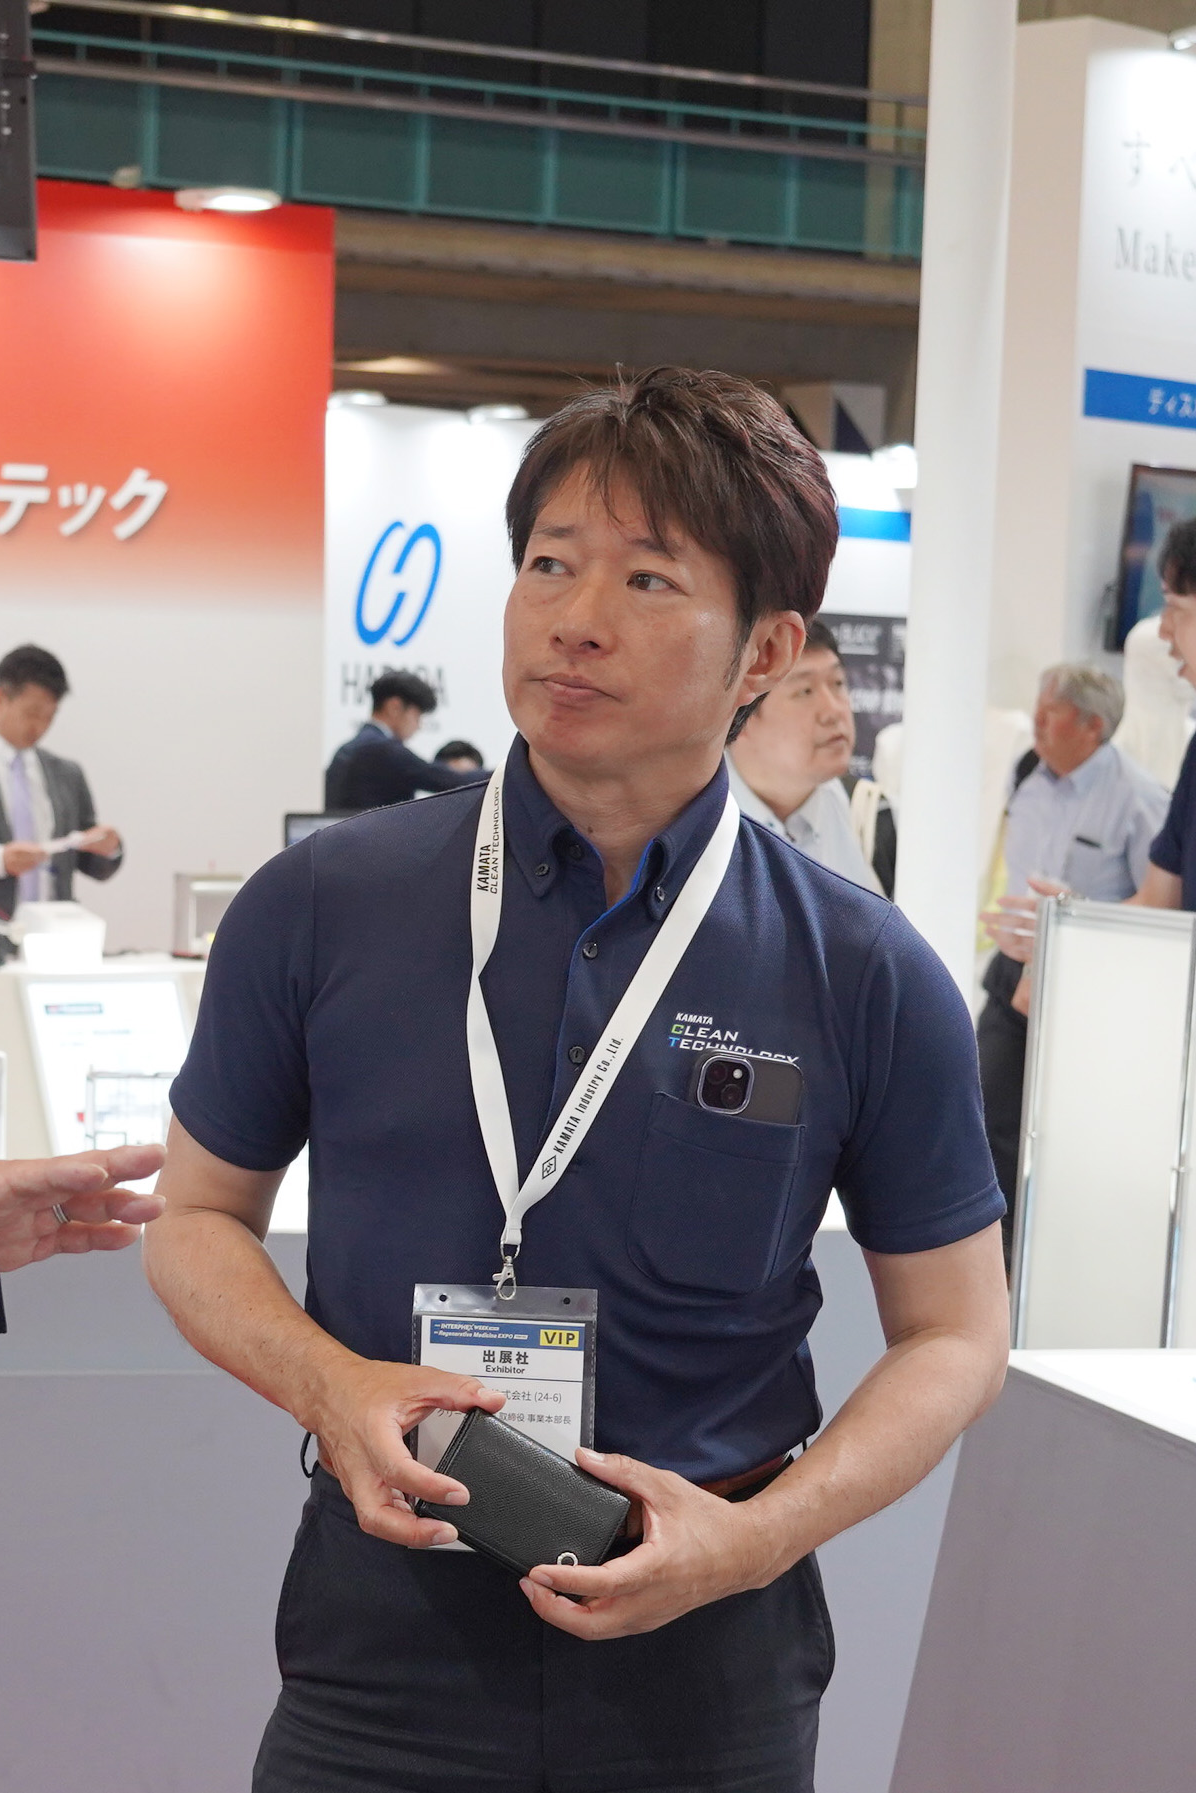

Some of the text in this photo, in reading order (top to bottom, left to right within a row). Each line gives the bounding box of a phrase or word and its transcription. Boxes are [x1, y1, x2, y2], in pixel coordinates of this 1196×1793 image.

[489, 786, 500, 895] CLEAN TECHNOLOGY
[476, 844, 492, 892] KAMATA
[675, 1012, 714, 1025] KAMATA
[670, 1023, 739, 1042] CLEAN
[553, 1115, 581, 1154] KAMATA
[574, 1074, 604, 1114] Industry
[544, 1331, 575, 1345] VIP
[482, 1350, 529, 1366] 出展社
[485, 1364, 526, 1375] Exhibitor
[534, 1392, 562, 1404] (24-6)
[527, 1413, 572, 1426] 事業本部長
